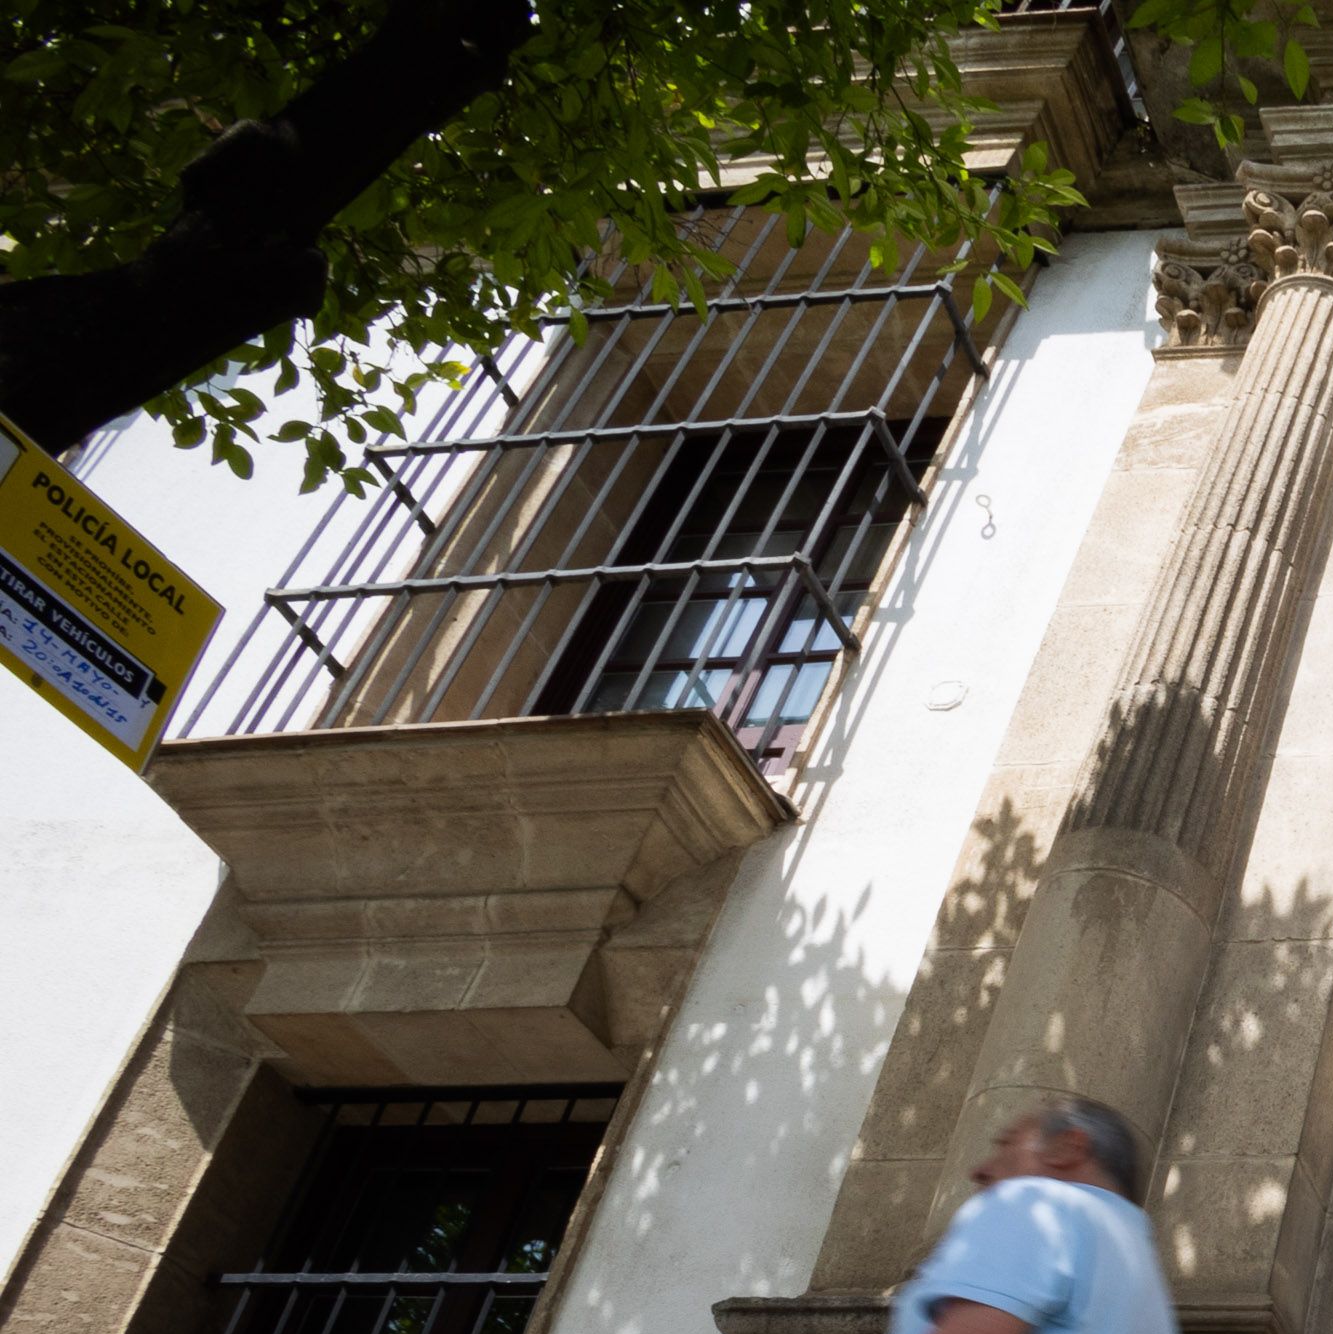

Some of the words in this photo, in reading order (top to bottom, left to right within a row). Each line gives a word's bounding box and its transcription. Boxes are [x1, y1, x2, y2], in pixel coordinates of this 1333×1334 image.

[32, 471, 117, 556] POLICÍA
[121, 548, 186, 615] LOCAL
[69, 535, 82, 547] SE
[33, 529, 46, 542] EL
[50, 543, 156, 636] ESTACIONAMIENTO
[38, 556, 63, 580] CON
[65, 580, 110, 620] MOTIVO
[47, 552, 63, 568] EN
[65, 568, 93, 594] ESTA
[96, 595, 128, 625] CALLE
[52, 609, 135, 684] VEHÍCULOS
